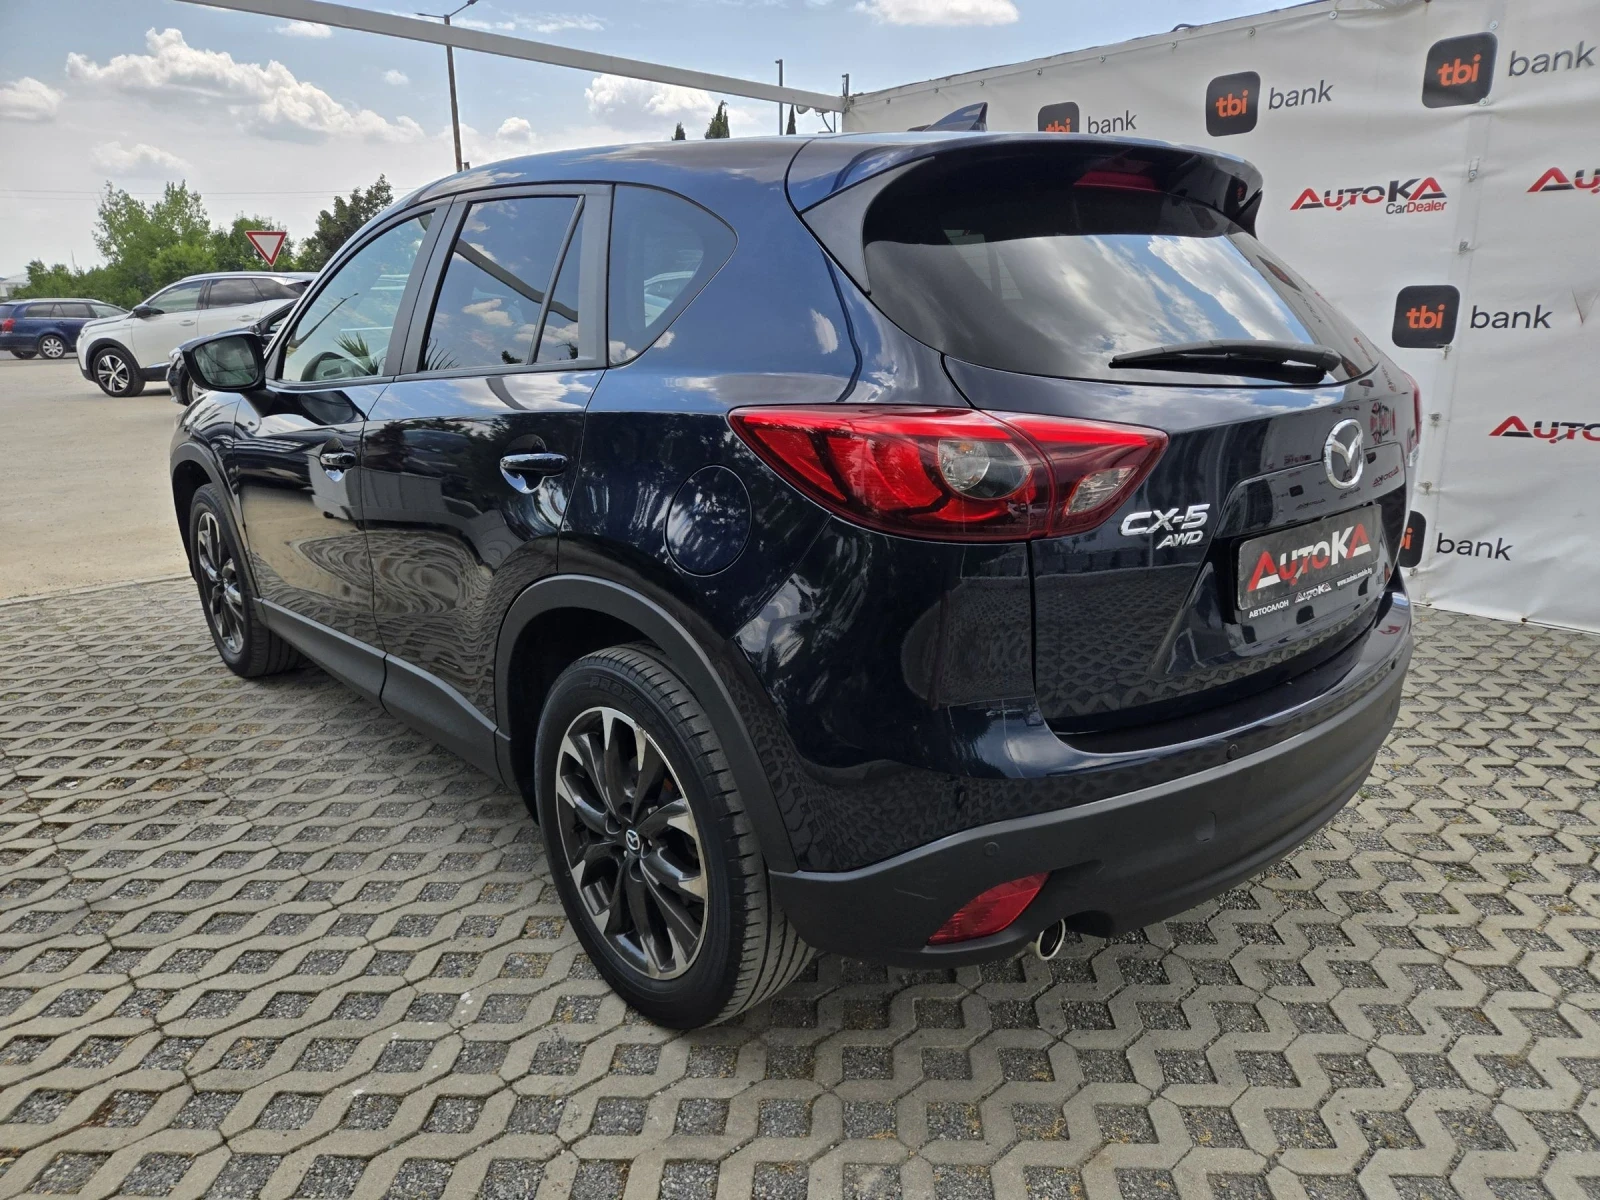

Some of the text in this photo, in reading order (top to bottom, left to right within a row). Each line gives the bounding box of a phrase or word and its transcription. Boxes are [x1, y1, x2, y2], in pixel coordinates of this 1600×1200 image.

[1437, 40, 1597, 87] tbi bank
[1215, 79, 1334, 118] tbi bank
[1087, 109, 1137, 134] bank
[1385, 200, 1448, 215] CarDealer
[1406, 304, 1553, 329] tbi bank
[1488, 415, 1600, 444] AUTO
[1120, 503, 1211, 537] CX-5
[1155, 530, 1204, 550] AWD
[1436, 532, 1514, 561] bank
[1248, 600, 1290, 619] АВТОСАЛОН
